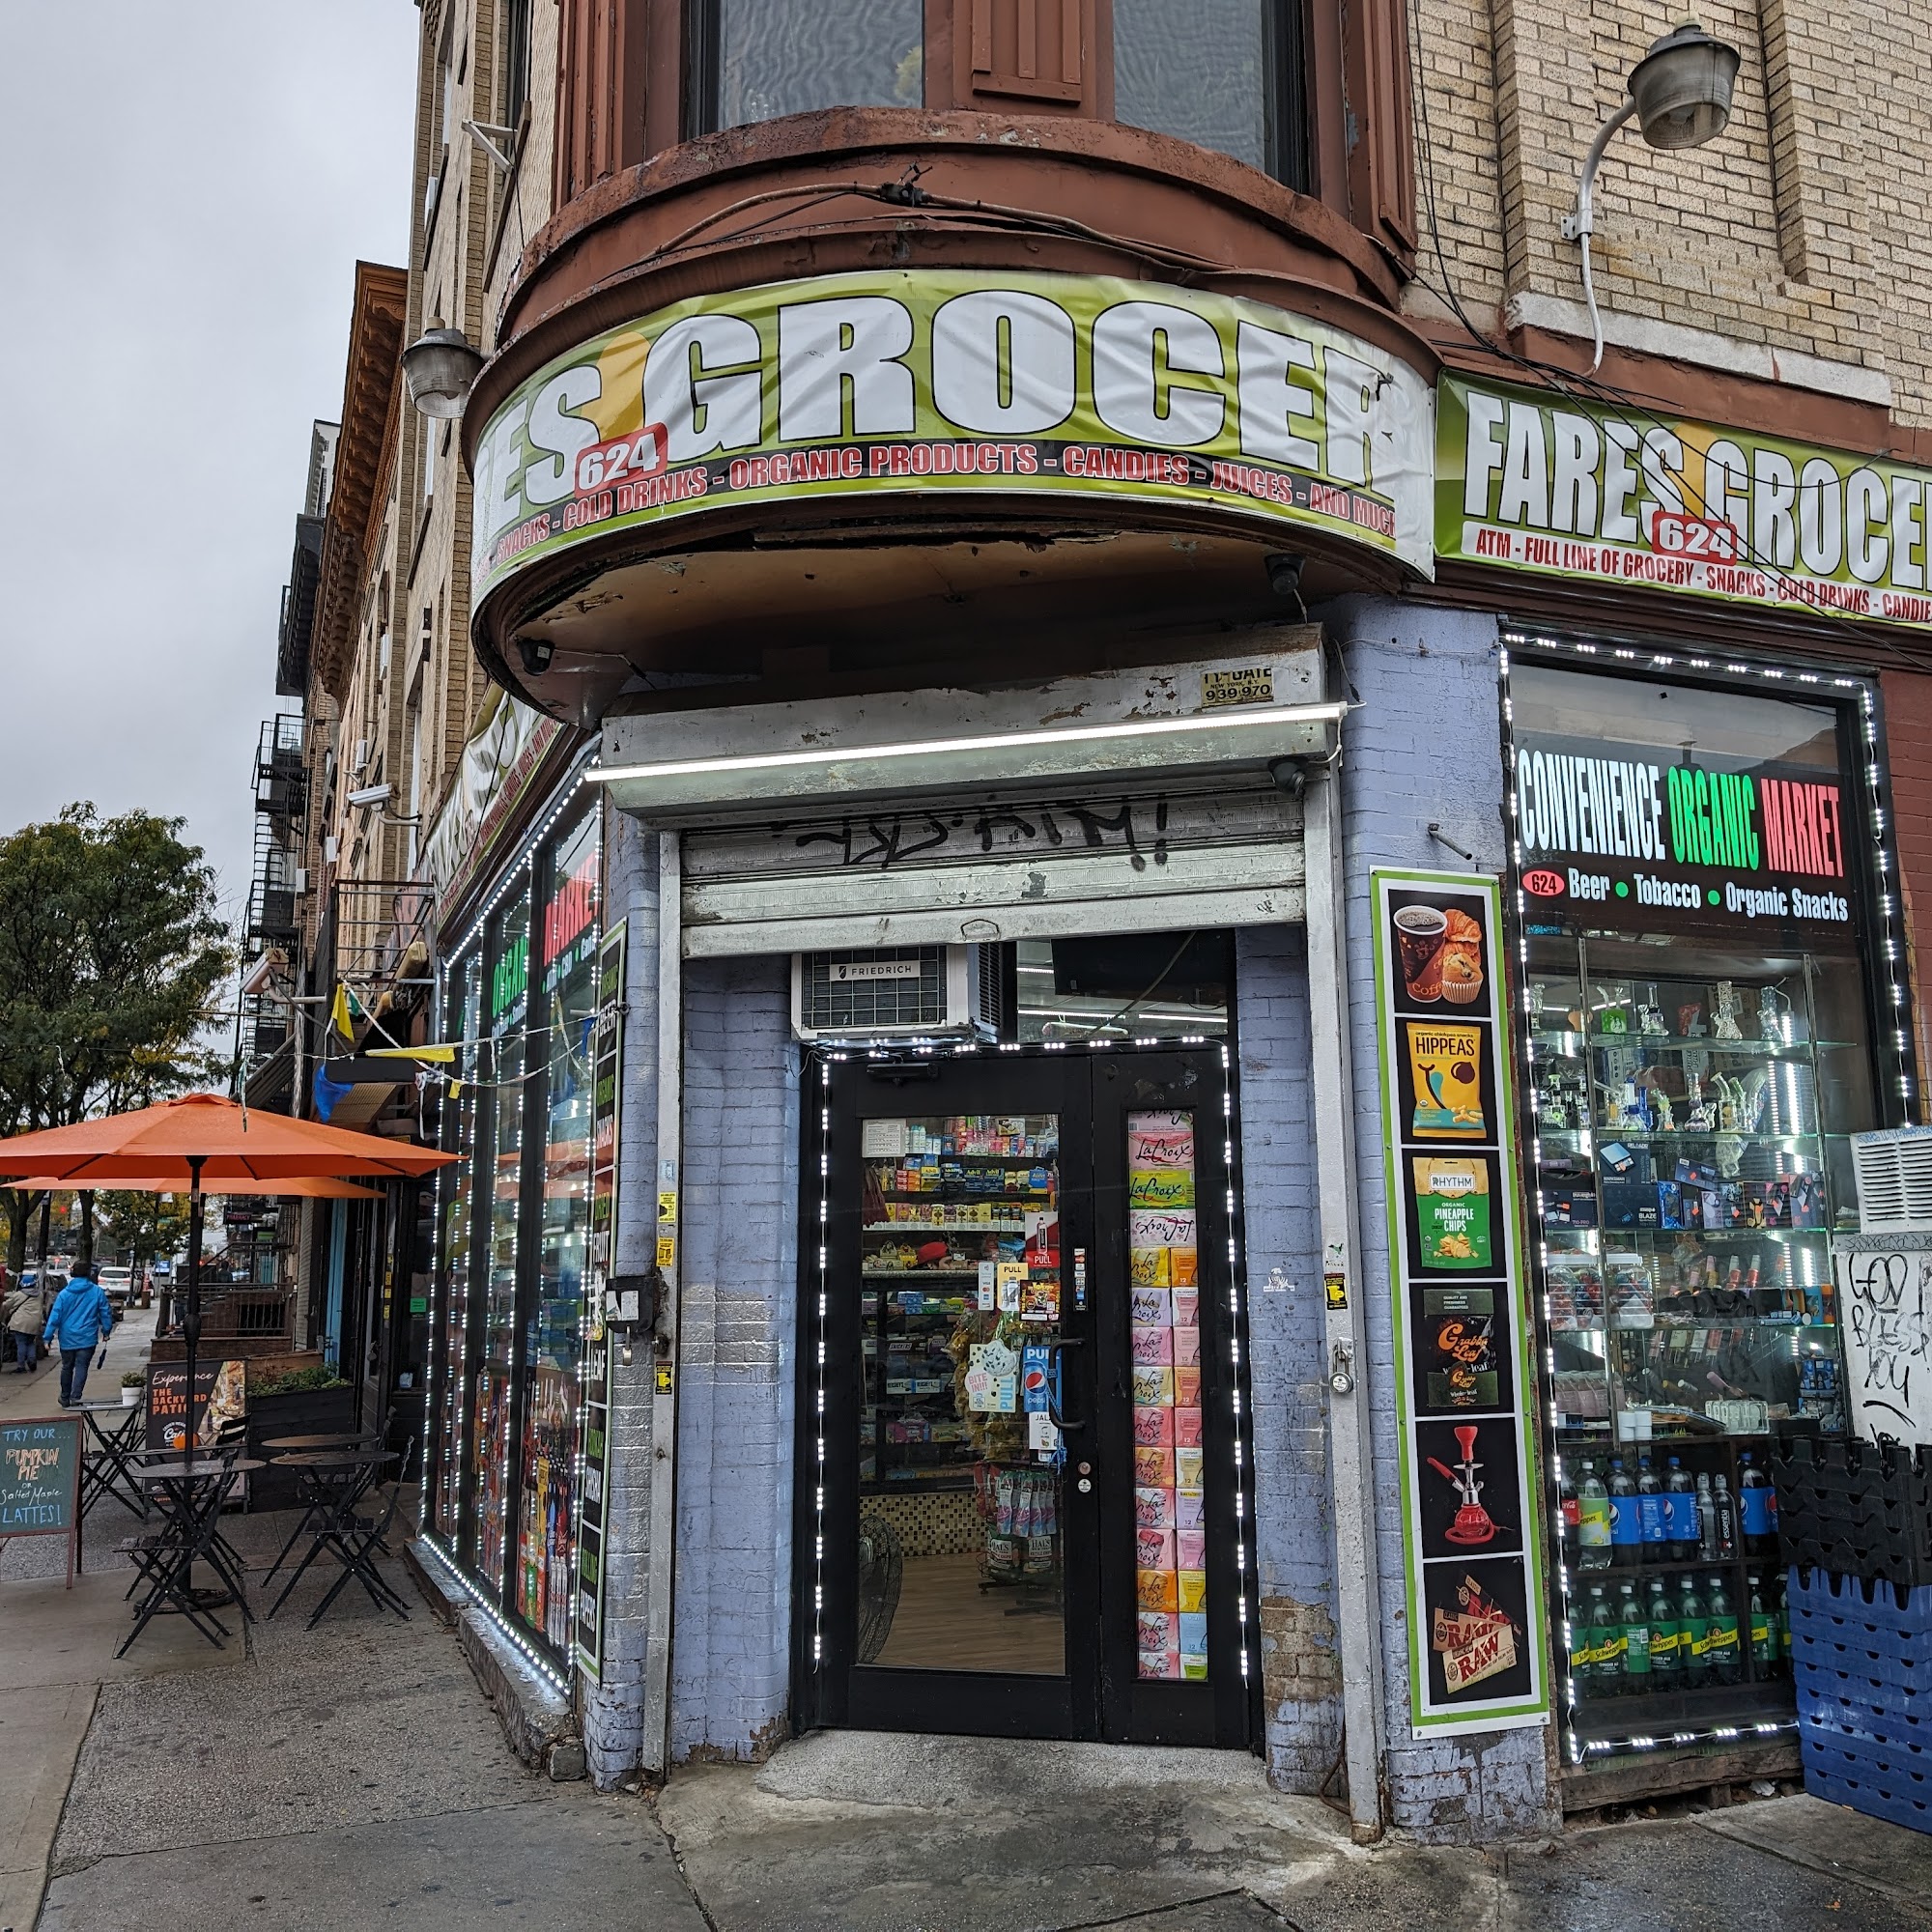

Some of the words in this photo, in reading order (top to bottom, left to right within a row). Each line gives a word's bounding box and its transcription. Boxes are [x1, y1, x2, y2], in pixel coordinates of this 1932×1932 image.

[579, 432, 661, 490] 624
[1463, 390, 1686, 544] FARES
[496, 512, 551, 566] SNACKS
[562, 489, 613, 531] COLD
[617, 466, 708, 517] DRINKS
[729, 448, 863, 491] ORGANIC
[869, 442, 1037, 477] PRODUCTS
[1064, 445, 1189, 485] CANDIES
[1209, 460, 1293, 505] JUICES
[1309, 482, 1350, 521] AND
[1658, 519, 1735, 559] 624
[1476, 527, 1511, 559] ATM
[1524, 536, 1560, 567] FULL
[1563, 542, 1597, 573] LINE
[1601, 547, 1620, 577] OF
[1623, 552, 1693, 586] GROCERY
[1706, 565, 1767, 599] SNACKS
[1777, 575, 1816, 608] COLD
[1818, 582, 1870, 613] DRINKS
[1518, 748, 1666, 862] CONVENIENCE
[1666, 765, 1760, 871] ORGANIC
[1760, 778, 1845, 878] MARKET
[1531, 873, 1557, 895] 624
[1568, 867, 1611, 901] Beer
[1633, 872, 1702, 909] Tobacco
[1724, 881, 1788, 919] Organic
[1792, 887, 1849, 922] Snacks
[851, 965, 912, 977] FRIEDRICH
[1411, 982, 1442, 996] Coff
[1415, 1037, 1475, 1057] HIPPEAS
[1432, 1177, 1473, 1187] RHYTHM
[1434, 1208, 1474, 1220] PINEAPPLE
[1443, 1220, 1467, 1232] CHIPS
[592, 1230, 611, 1264] FRUIT
[1034, 1255, 1052, 1264] PULL
[152, 1371, 213, 1388] Expernce
[968, 1373, 988, 1384] BITE
[971, 1381, 988, 1393] IN!!!
[153, 1388, 172, 1397] THE
[153, 1394, 207, 1405] BACKYRD
[1000, 1377, 1013, 1410] PULL
[2, 1429, 28, 1442] TRY
[17, 1464, 41, 1481] PIE
[0, 1489, 31, 1505] Salted
[28, 1487, 63, 1506] Maple
[2, 1504, 62, 1525] LATTES!
[1720, 1509, 1730, 1539] essentia
[1447, 1623, 1494, 1648] RAW
[1457, 1631, 1500, 1683] RAW
